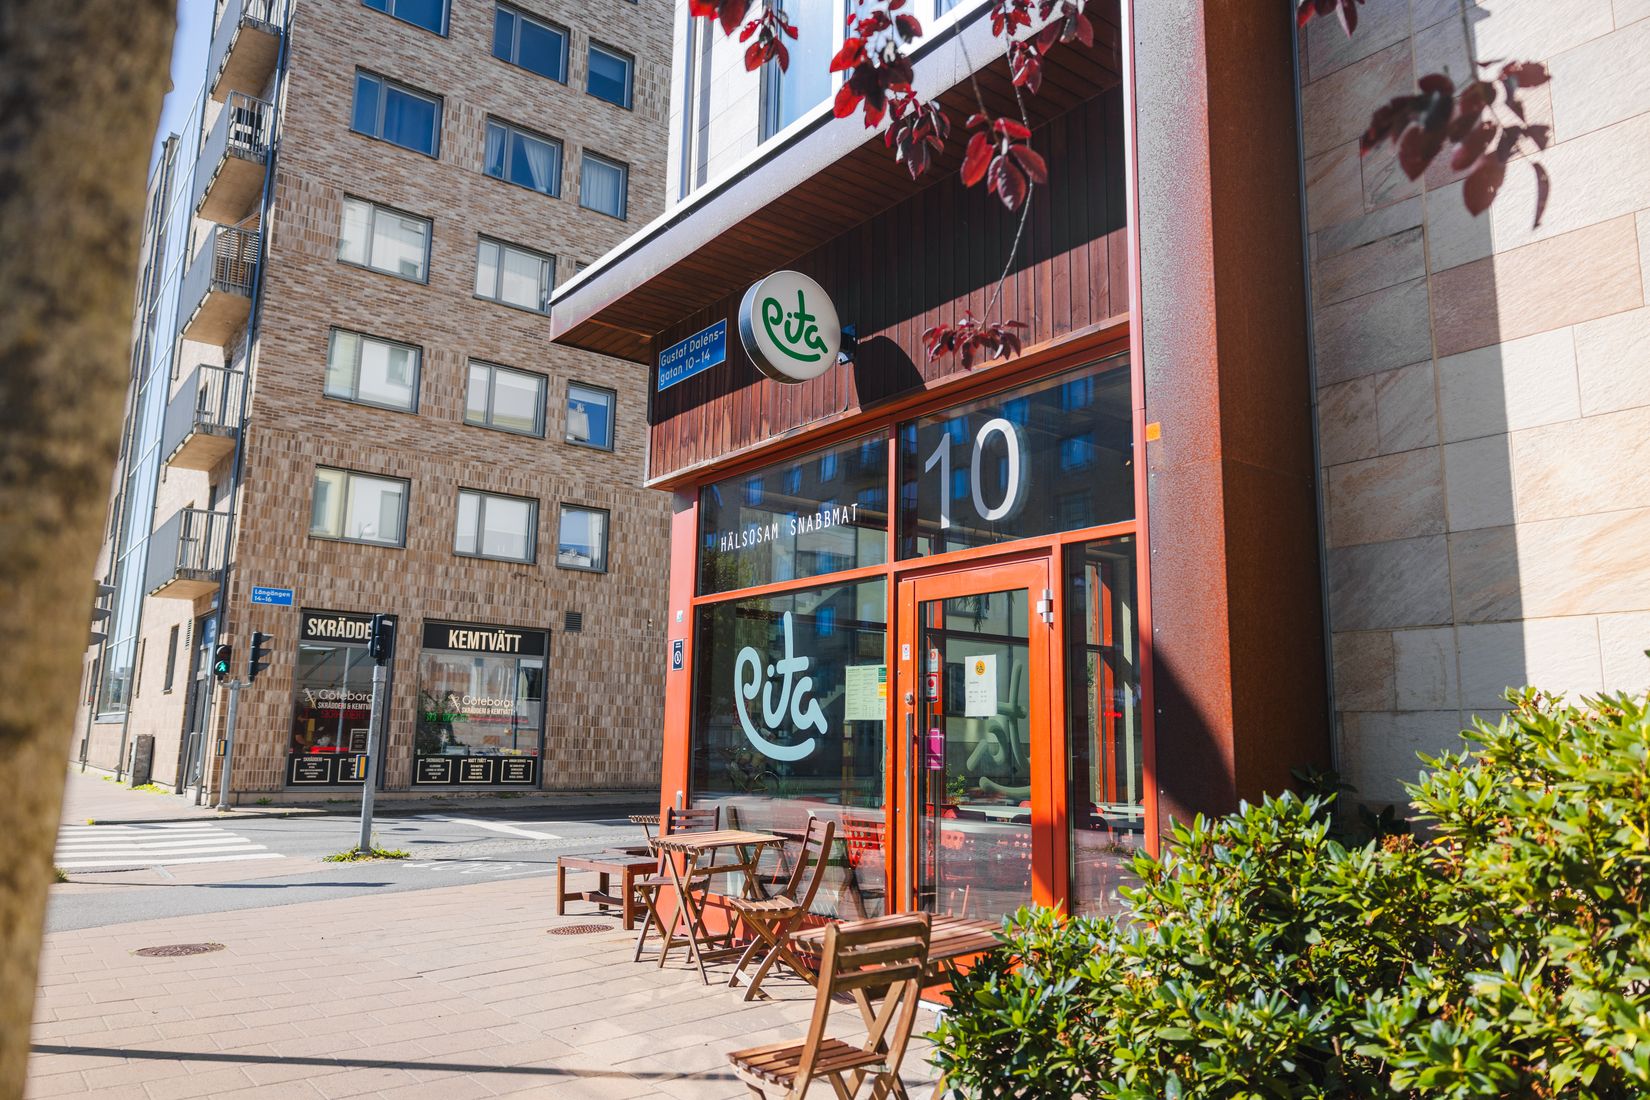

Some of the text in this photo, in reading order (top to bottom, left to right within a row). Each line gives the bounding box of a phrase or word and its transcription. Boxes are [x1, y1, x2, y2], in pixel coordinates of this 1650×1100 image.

[661, 330, 724, 367] Gustaf Daléns-
[660, 348, 710, 386] gatan 10-14
[925, 418, 1019, 529] 10
[720, 503, 858, 552] HÄLSOSAM SNABBMAT
[307, 617, 372, 639] SKRÄDDE
[448, 629, 522, 652] KEMTVÄTT
[318, 688, 373, 703] Göteborg
[462, 695, 514, 709] Göteborgs
